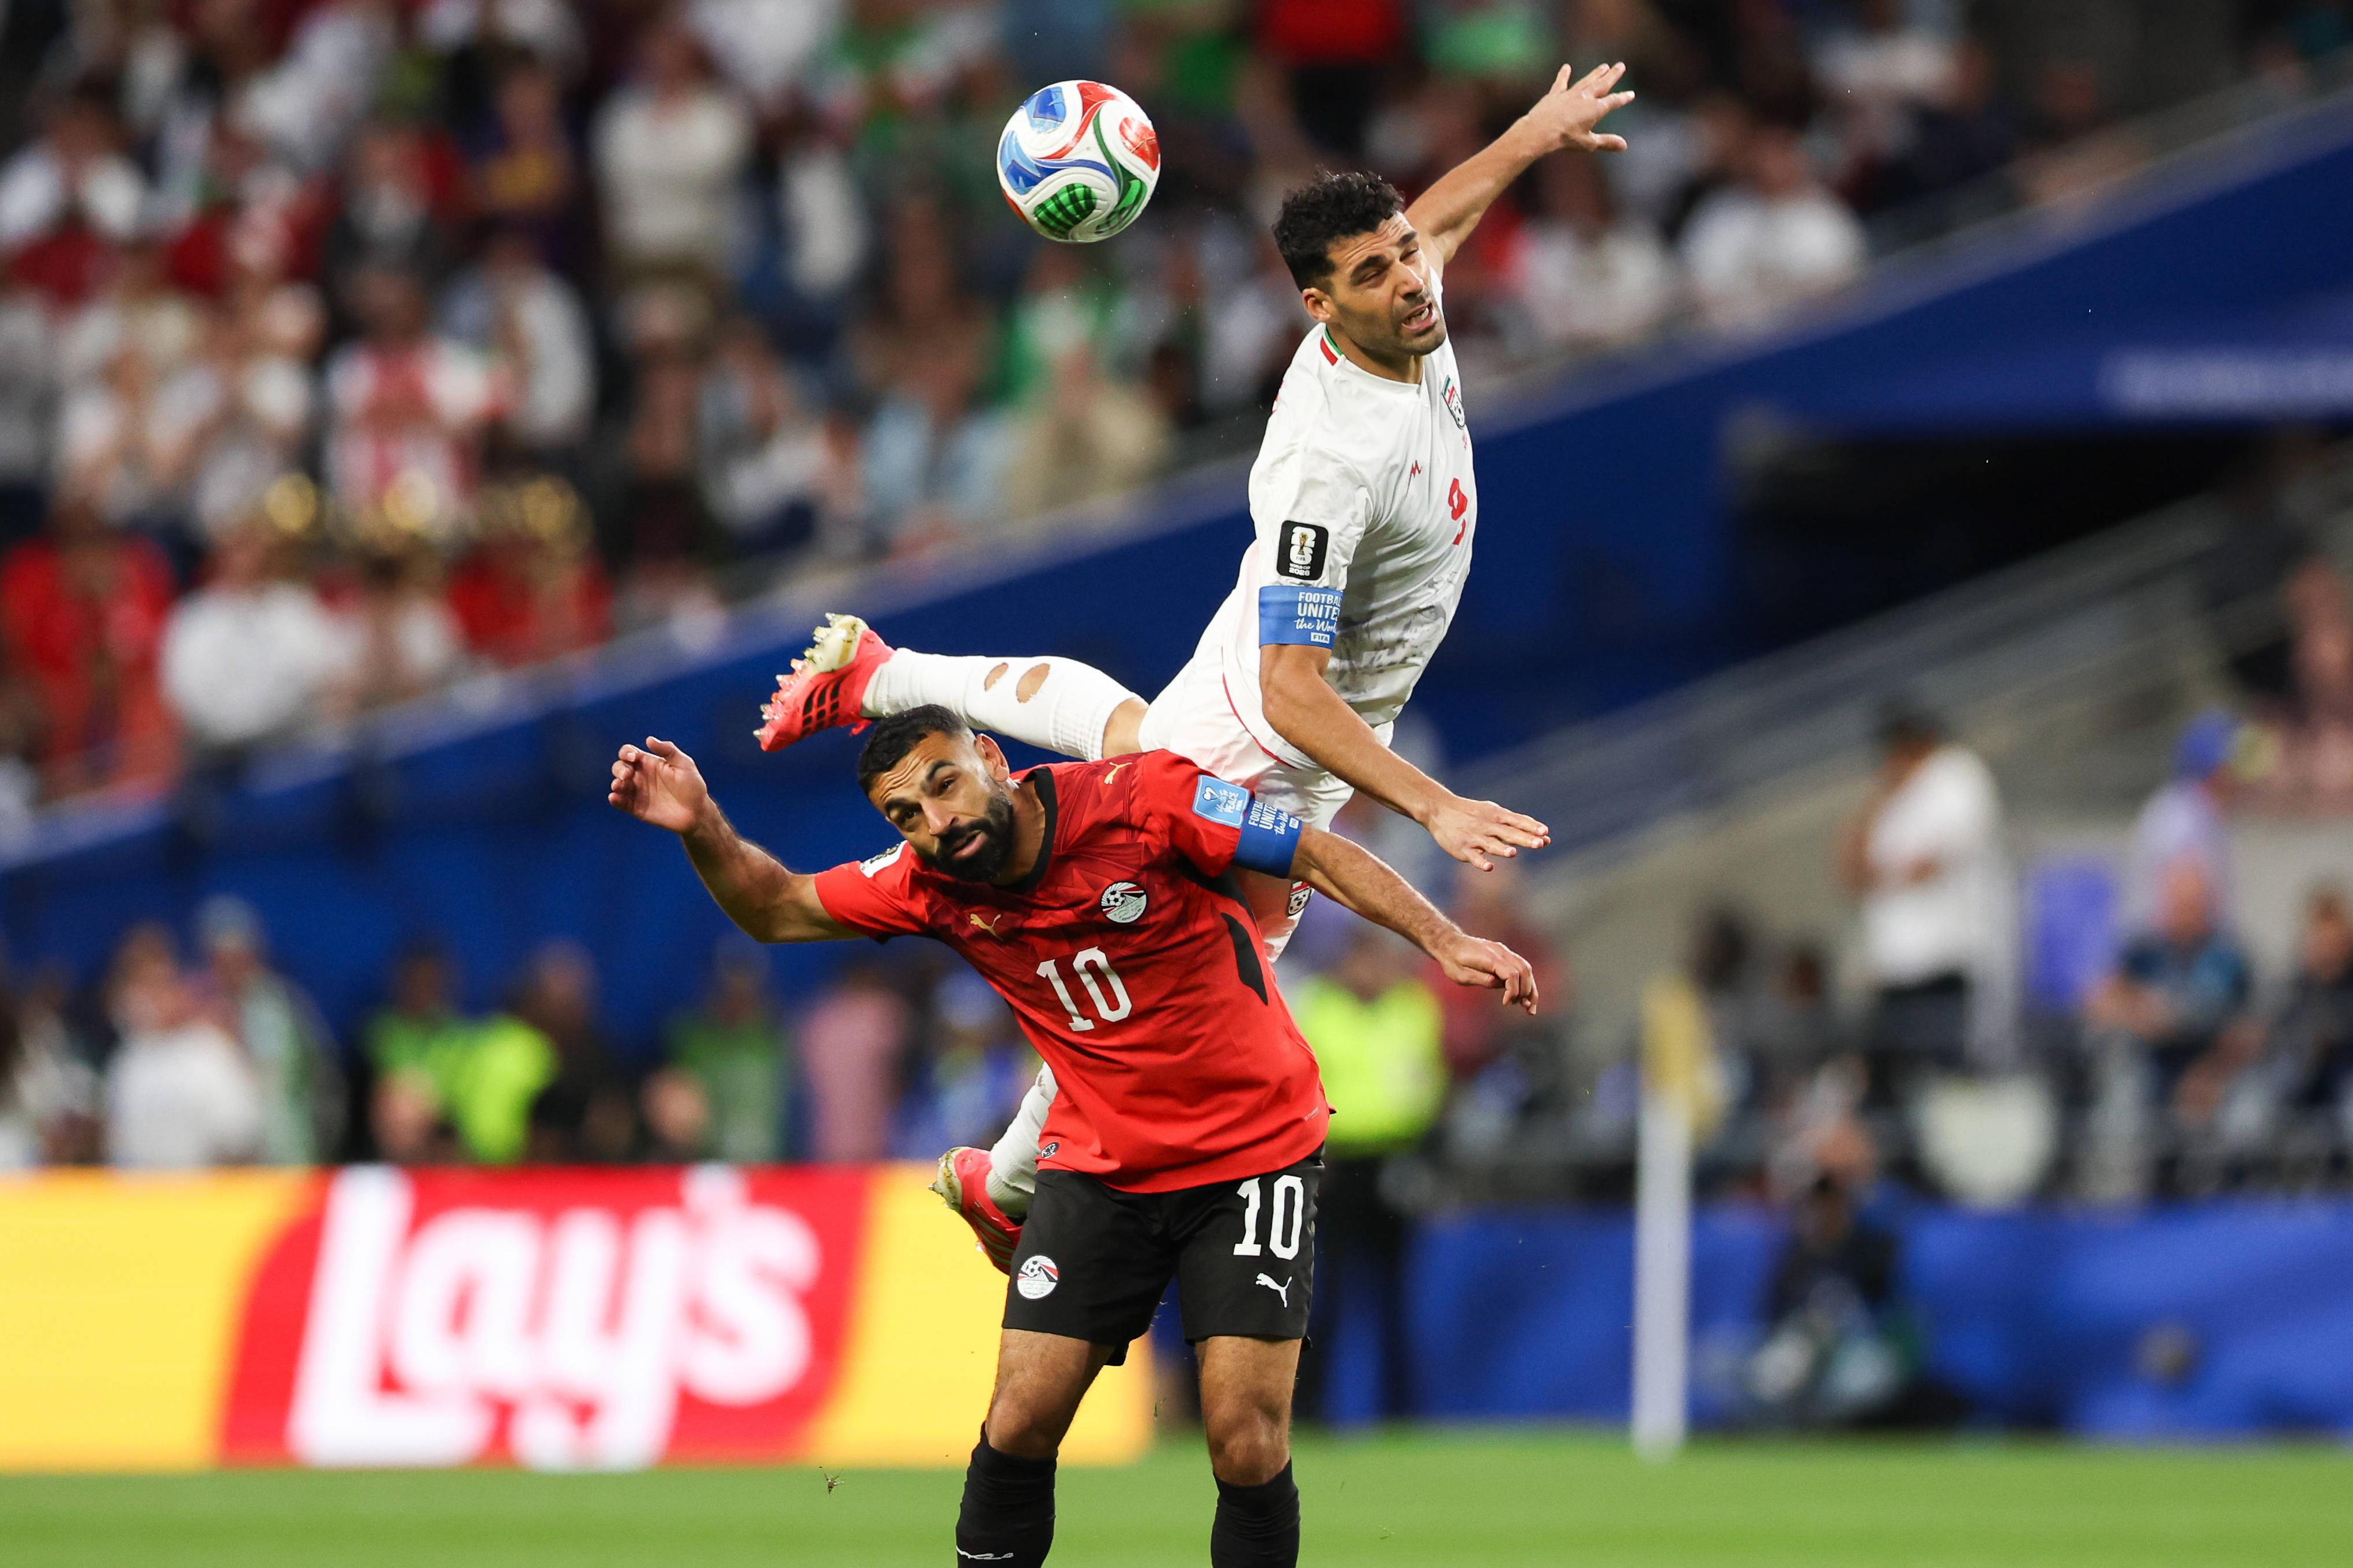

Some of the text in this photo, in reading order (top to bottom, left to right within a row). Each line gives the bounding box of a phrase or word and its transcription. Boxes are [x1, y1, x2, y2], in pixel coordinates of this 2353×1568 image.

[1447, 478, 1468, 546] 9
[1288, 567, 1310, 576] 2026
[1294, 617, 1314, 629] the
[1036, 946, 1132, 1032] 10
[1233, 1174, 1304, 1260] 10
[286, 1163, 821, 1471] Lay's
